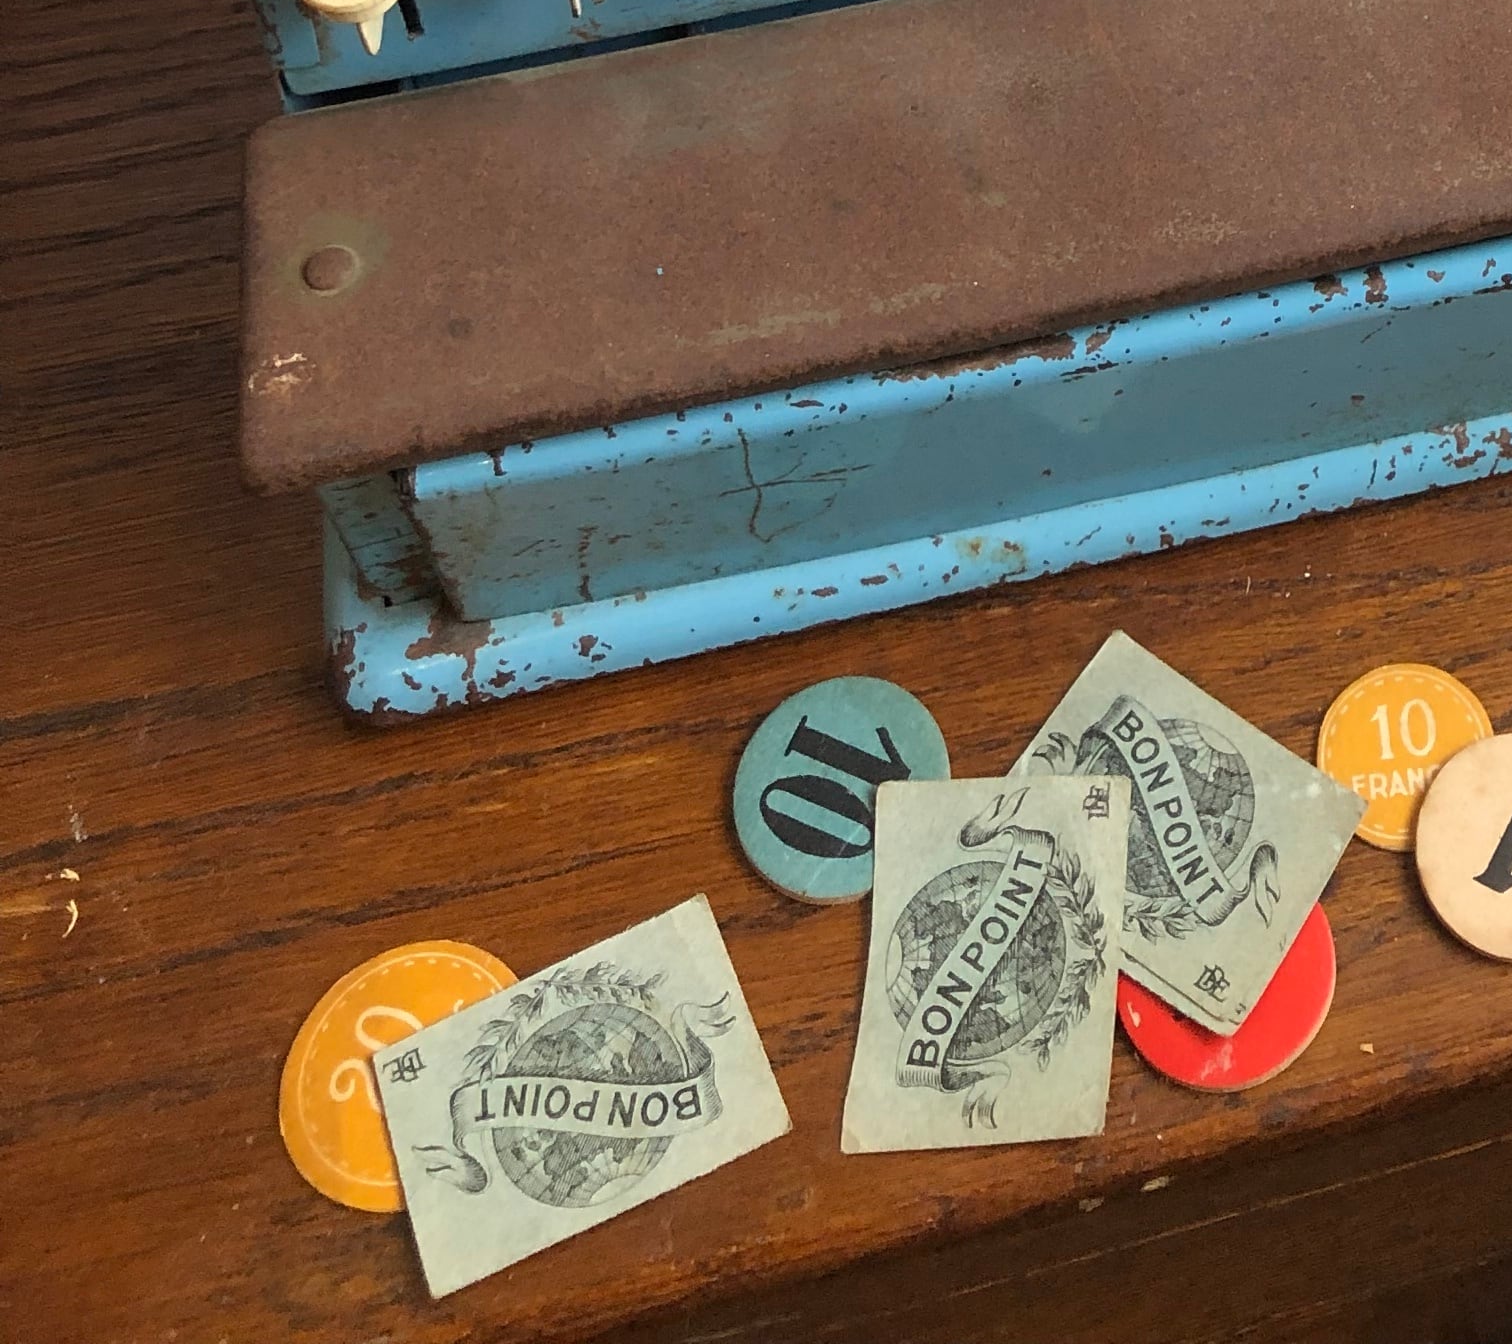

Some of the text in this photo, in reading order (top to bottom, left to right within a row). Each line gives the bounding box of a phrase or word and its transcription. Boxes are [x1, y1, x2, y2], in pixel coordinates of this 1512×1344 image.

[759, 716, 912, 859] 10
[1370, 698, 1436, 760] 10
[1112, 711, 1224, 905] BON POINT
[908, 850, 1044, 1069] BON POINT
[475, 1084, 702, 1128] BON POINT
